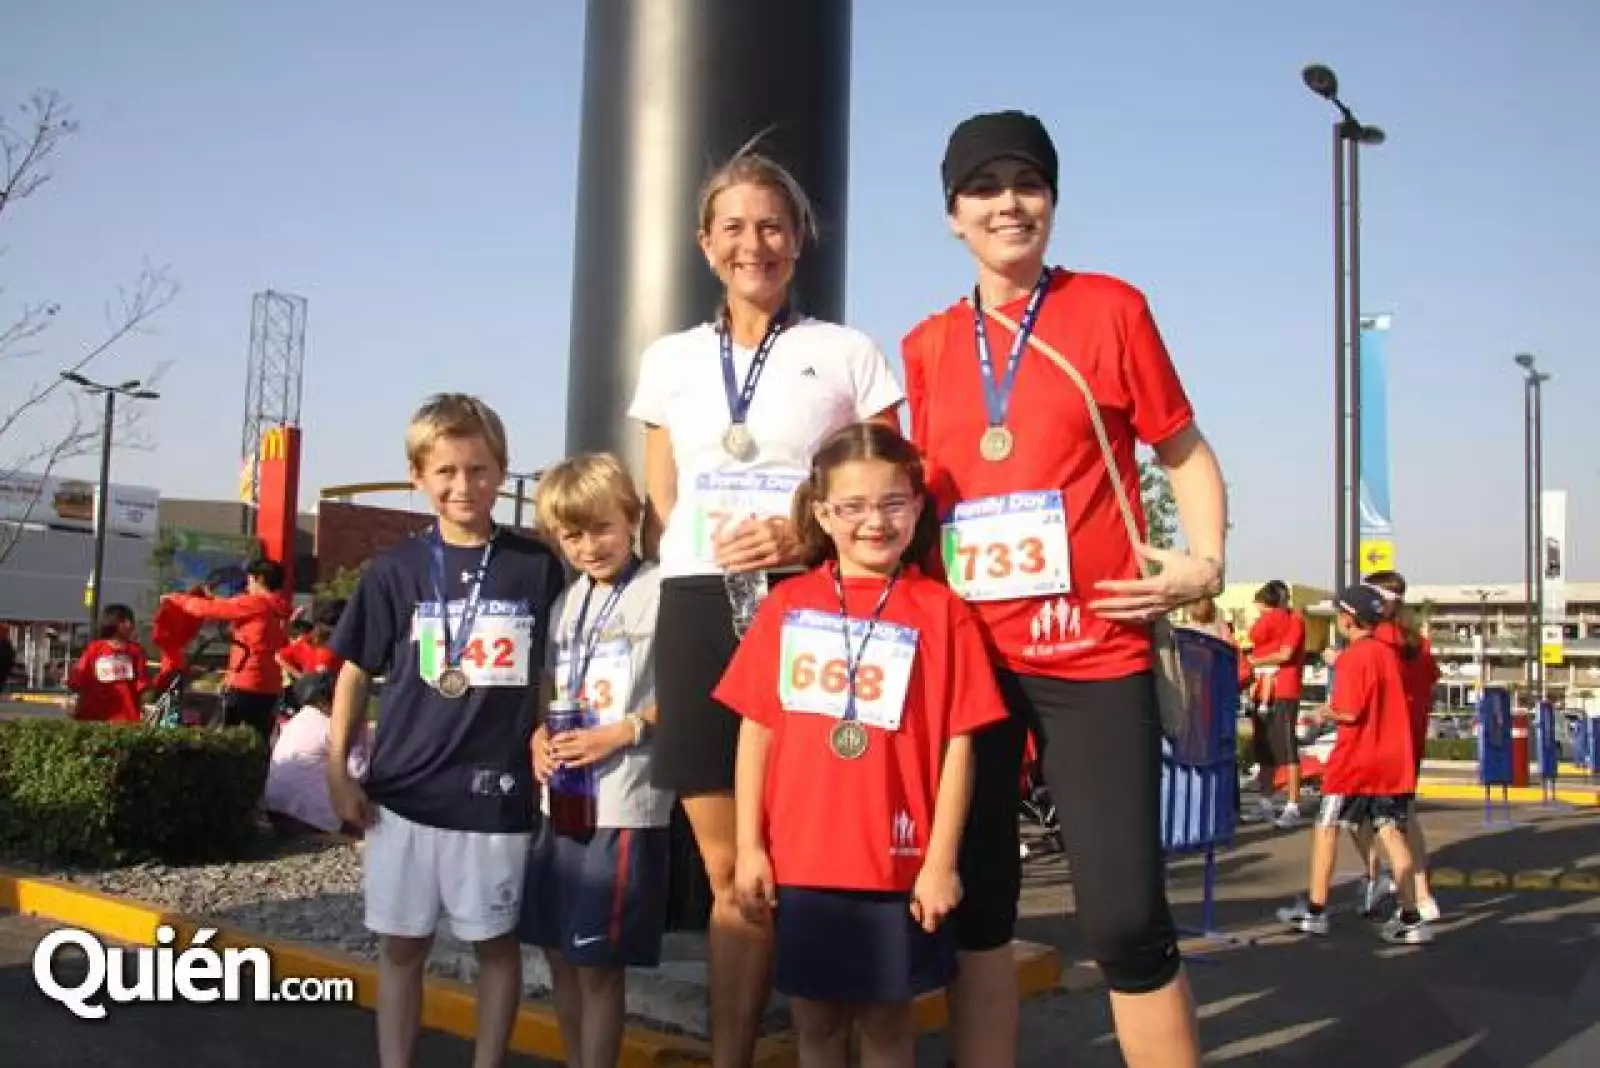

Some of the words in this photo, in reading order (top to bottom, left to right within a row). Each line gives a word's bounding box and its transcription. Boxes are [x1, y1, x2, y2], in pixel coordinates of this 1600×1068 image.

[1009, 493, 1046, 511] Day
[956, 537, 1046, 581] 733
[435, 638, 515, 668] 42
[791, 652, 885, 702] 668
